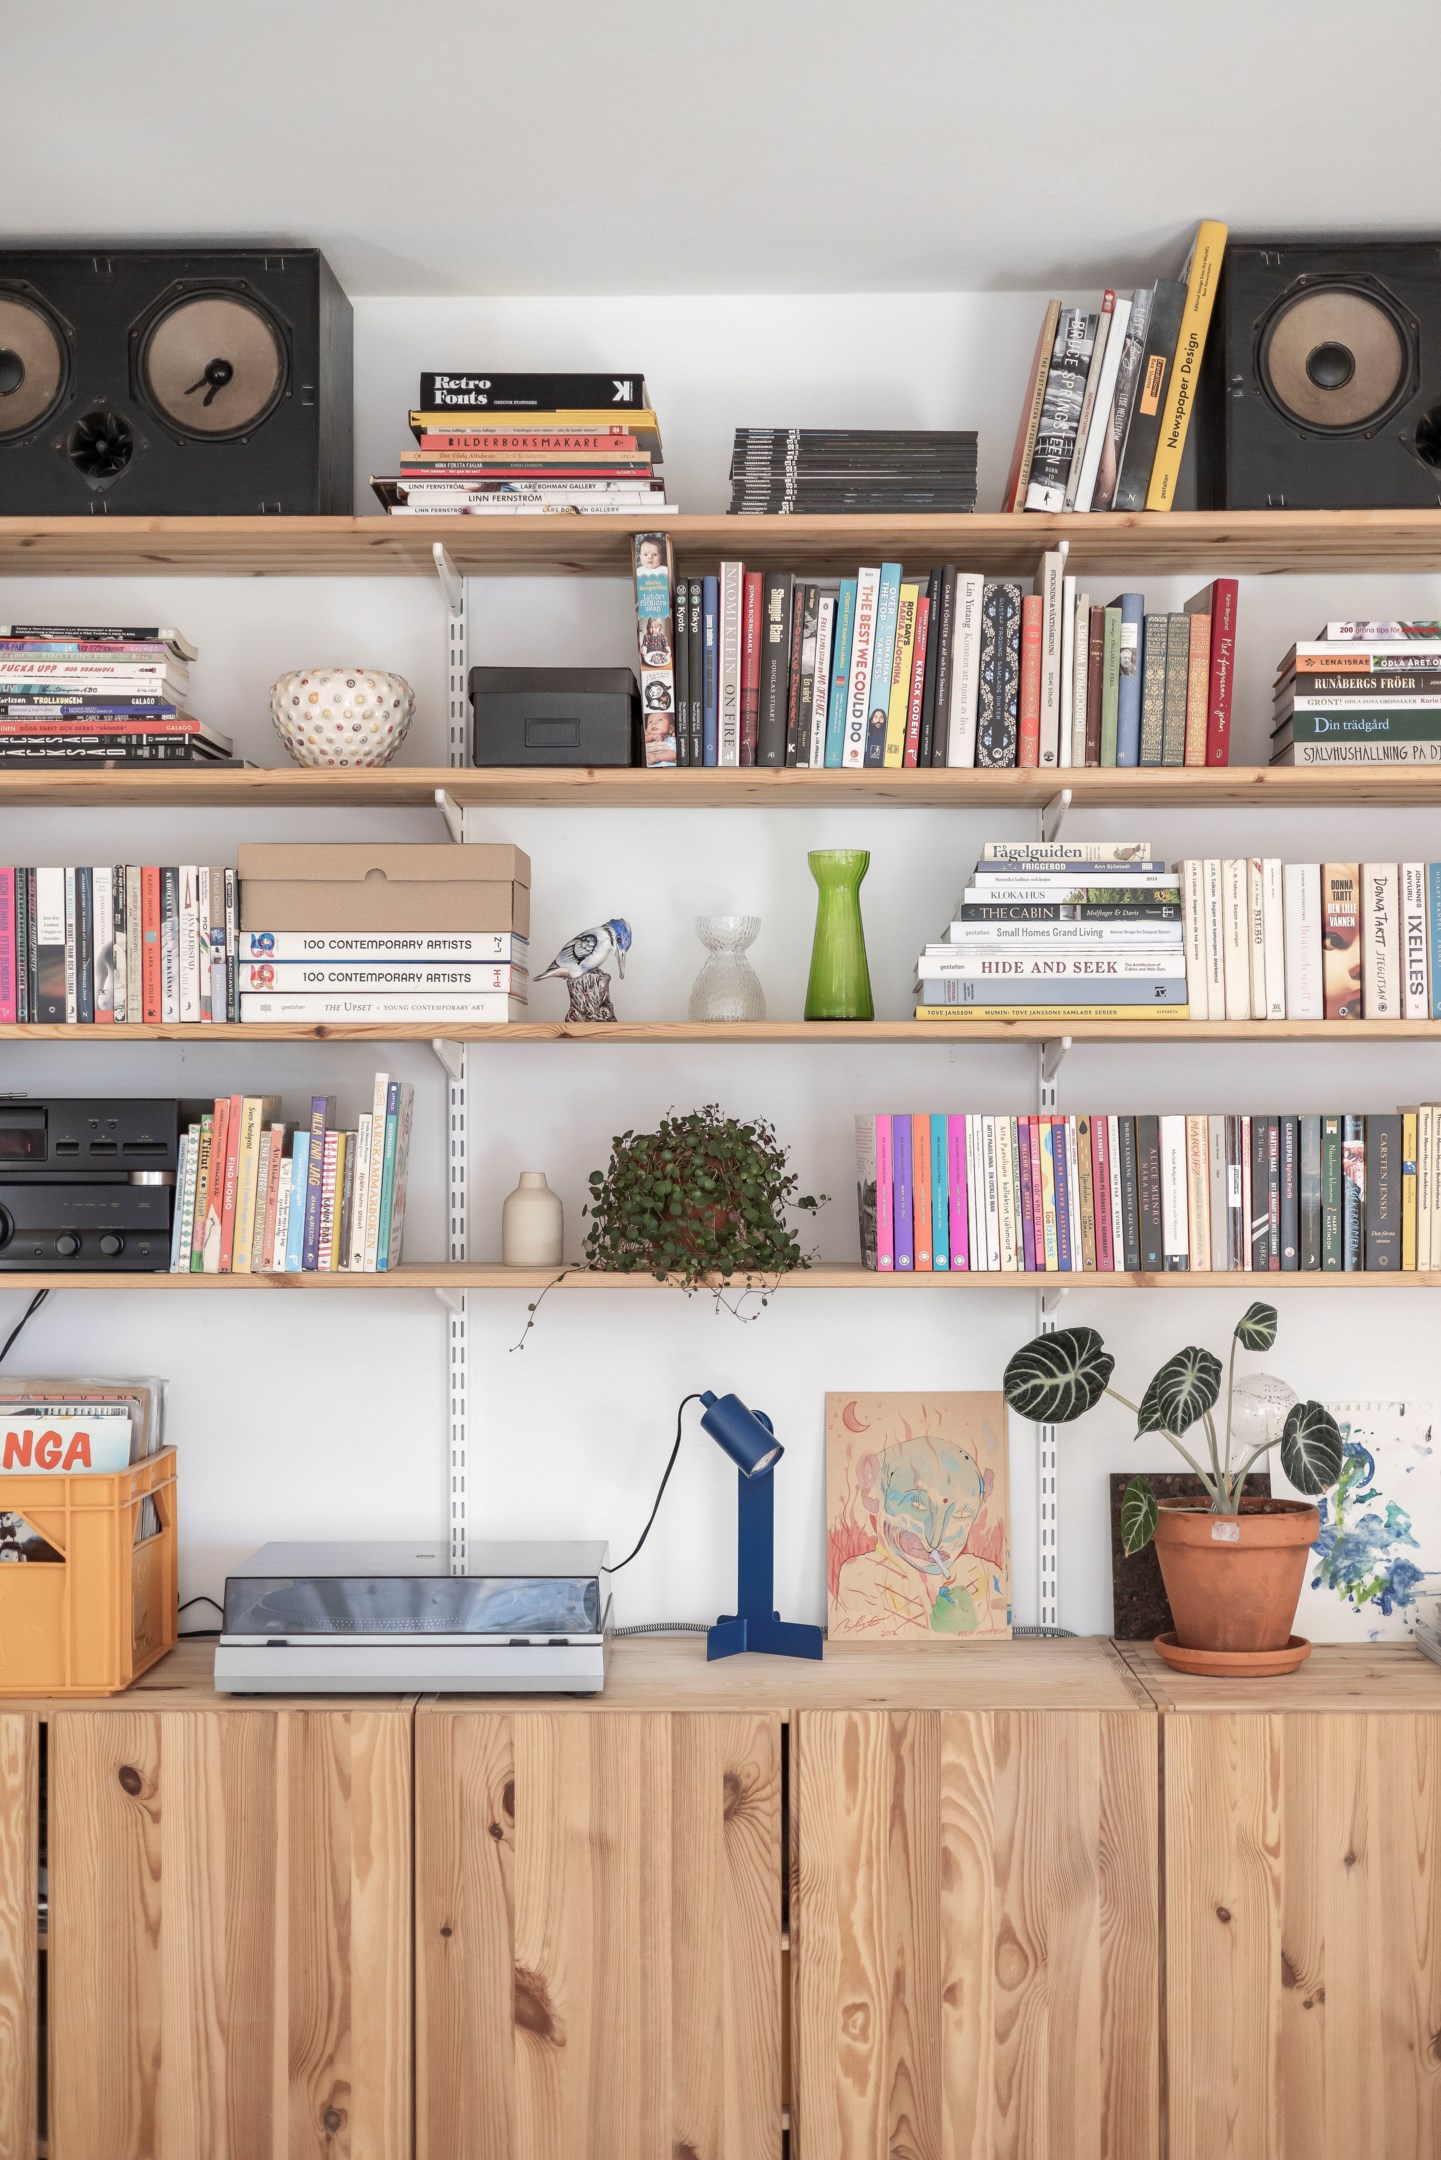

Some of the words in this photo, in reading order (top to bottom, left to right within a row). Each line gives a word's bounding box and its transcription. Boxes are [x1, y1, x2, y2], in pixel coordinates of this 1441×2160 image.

[1064, 320, 1085, 366] BRUCE
[434, 376, 491, 389] Retro
[1167, 377, 1189, 449] Newspaper
[1181, 332, 1198, 374] Design
[434, 390, 488, 404] Fonts
[1033, 388, 1042, 419] AMERICAN
[1046, 371, 1076, 464] SPRINGSTEEN
[448, 438, 598, 447] BILDERBOKSMAKARE
[725, 567, 737, 620] NAOMI
[861, 586, 873, 611] THE
[888, 588, 896, 614] OVER
[966, 582, 975, 597] Lin
[768, 588, 784, 621] Shuggie
[898, 601, 907, 630] MARIA
[905, 601, 914, 622] RIOT
[962, 599, 974, 628] Yutang
[677, 607, 685, 632] Kyoto
[691, 607, 699, 633] Tokyo
[858, 614, 871, 645] BEST
[1376, 626, 1389, 635] tips
[770, 624, 783, 642] Bain
[904, 623, 912, 646] DAYS
[1078, 621, 1087, 662] WINFREY
[726, 627, 736, 673] KLEIN
[856, 648, 868, 668] WE
[893, 633, 903, 685] ALJOCHINA
[914, 660, 923, 696] KNÄCK
[1314, 675, 1377, 689] RUNÅBERGS
[1381, 676, 1415, 688] FRÖER
[724, 684, 736, 707] ON
[852, 671, 866, 718] COULD
[1076, 667, 1087, 732] ROBOCOPRAH
[724, 713, 735, 747] FIRE
[850, 722, 862, 742] DO
[1314, 718, 1340, 732] Din
[1343, 718, 1389, 732] trädgård
[992, 845, 1082, 862] Fågelguiden
[1331, 880, 1353, 890] DONNA
[1332, 891, 1352, 901] TARTT
[1373, 877, 1388, 912] DONNA
[980, 908, 1008, 919] THE
[1009, 908, 1054, 918] CABIN
[1328, 904, 1340, 914] DEN
[1342, 903, 1357, 913] LILLE
[1330, 915, 1355, 927] VÄNNEN
[997, 928, 1019, 937] Small
[1022, 928, 1050, 937] Homes
[1052, 928, 1077, 936] Grand
[1079, 928, 1103, 938] Living
[1254, 910, 1262, 944] BILBO
[1375, 913, 1388, 947] TARTT
[303, 940, 325, 949] 100
[328, 939, 423, 950] CONTEMPORARY
[426, 940, 472, 950] ARTISTS
[1408, 915, 1424, 995] IXELLES
[303, 972, 325, 982] 100
[328, 972, 423, 982] CONTEMPORARY
[426, 972, 472, 982] ARTISTS
[981, 962, 1024, 973] HIDE
[1031, 961, 1066, 973] AND
[1073, 962, 1118, 973] SEEK
[312, 1112, 323, 1135] HELA
[201, 1138, 212, 1169] Tittut
[260, 1137, 268, 1157] LENA
[311, 1138, 322, 1159] FINA
[308, 1163, 321, 1186] JAG
[367, 1115, 383, 1249] BARNKAMMARBOKEN
[226, 1181, 234, 1210] MOMO
[1379, 1182, 1387, 1220] JENSEN
[0, 1430, 92, 1470] NGA
